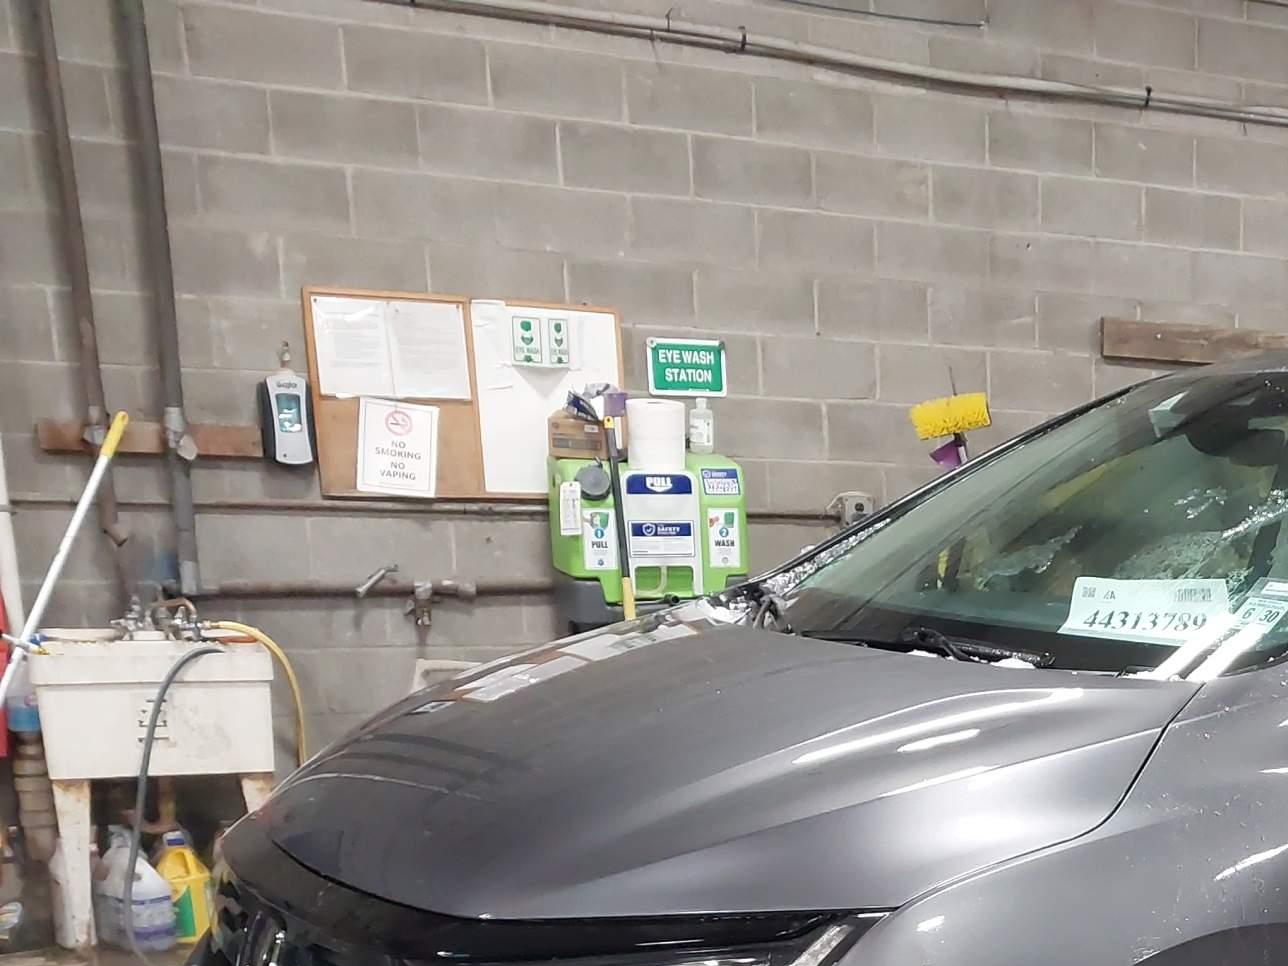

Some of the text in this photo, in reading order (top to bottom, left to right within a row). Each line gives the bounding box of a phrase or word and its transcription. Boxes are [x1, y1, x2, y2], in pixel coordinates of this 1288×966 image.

[658, 349, 714, 365] EYE WASH
[665, 368, 712, 384] STATION
[391, 440, 406, 449] NO
[375, 447, 422, 460] SMOKING
[390, 461, 405, 470] NO
[380, 470, 416, 480] VAPING
[645, 476, 672, 487] PULL
[714, 539, 735, 547] WASH
[1083, 609, 1207, 631] 44313789
[1242, 607, 1280, 623] 6 30
